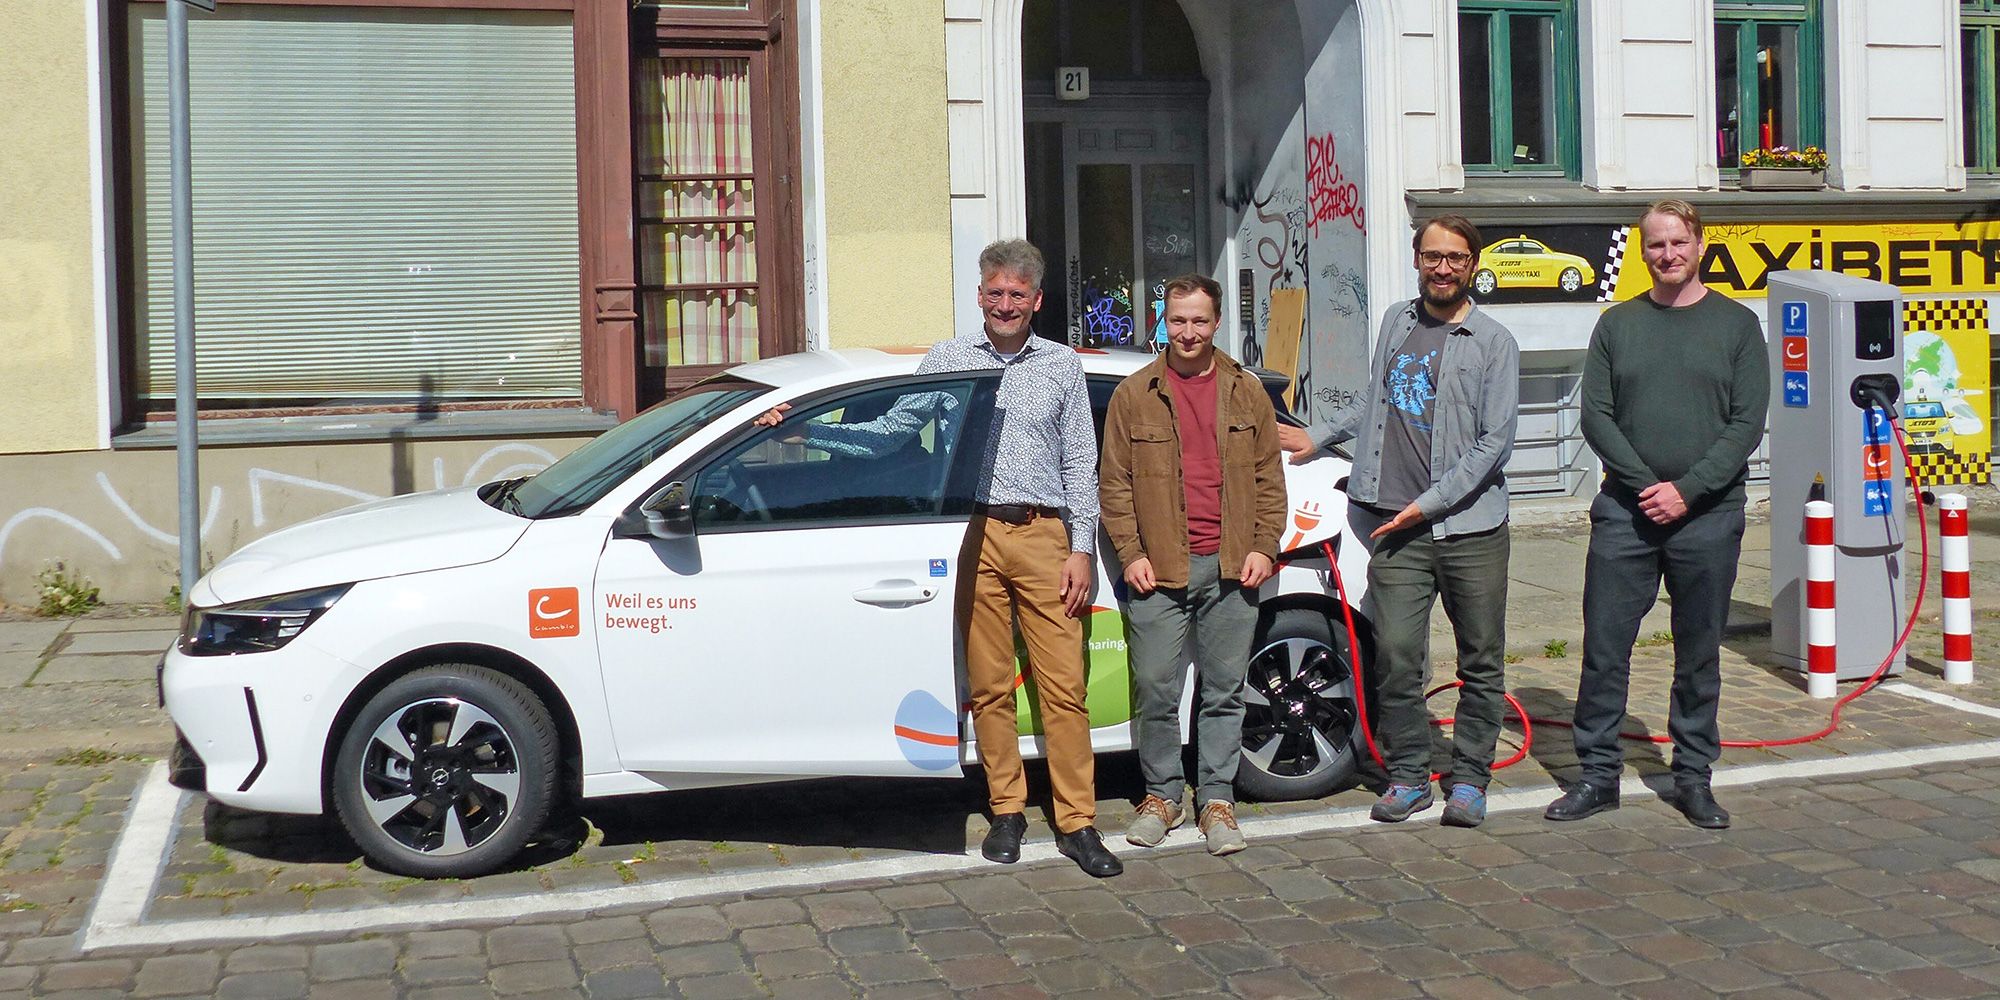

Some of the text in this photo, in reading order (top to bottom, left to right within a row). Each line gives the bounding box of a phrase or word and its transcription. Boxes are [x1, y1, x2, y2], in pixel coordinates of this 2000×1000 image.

[1066, 72, 1081, 91] 21
[1525, 270, 1540, 278] TAXI
[1791, 306, 1800, 326] P
[606, 593, 697, 609] Weil es uns
[534, 624, 575, 632] cambio
[606, 613, 673, 634] bewegt.
